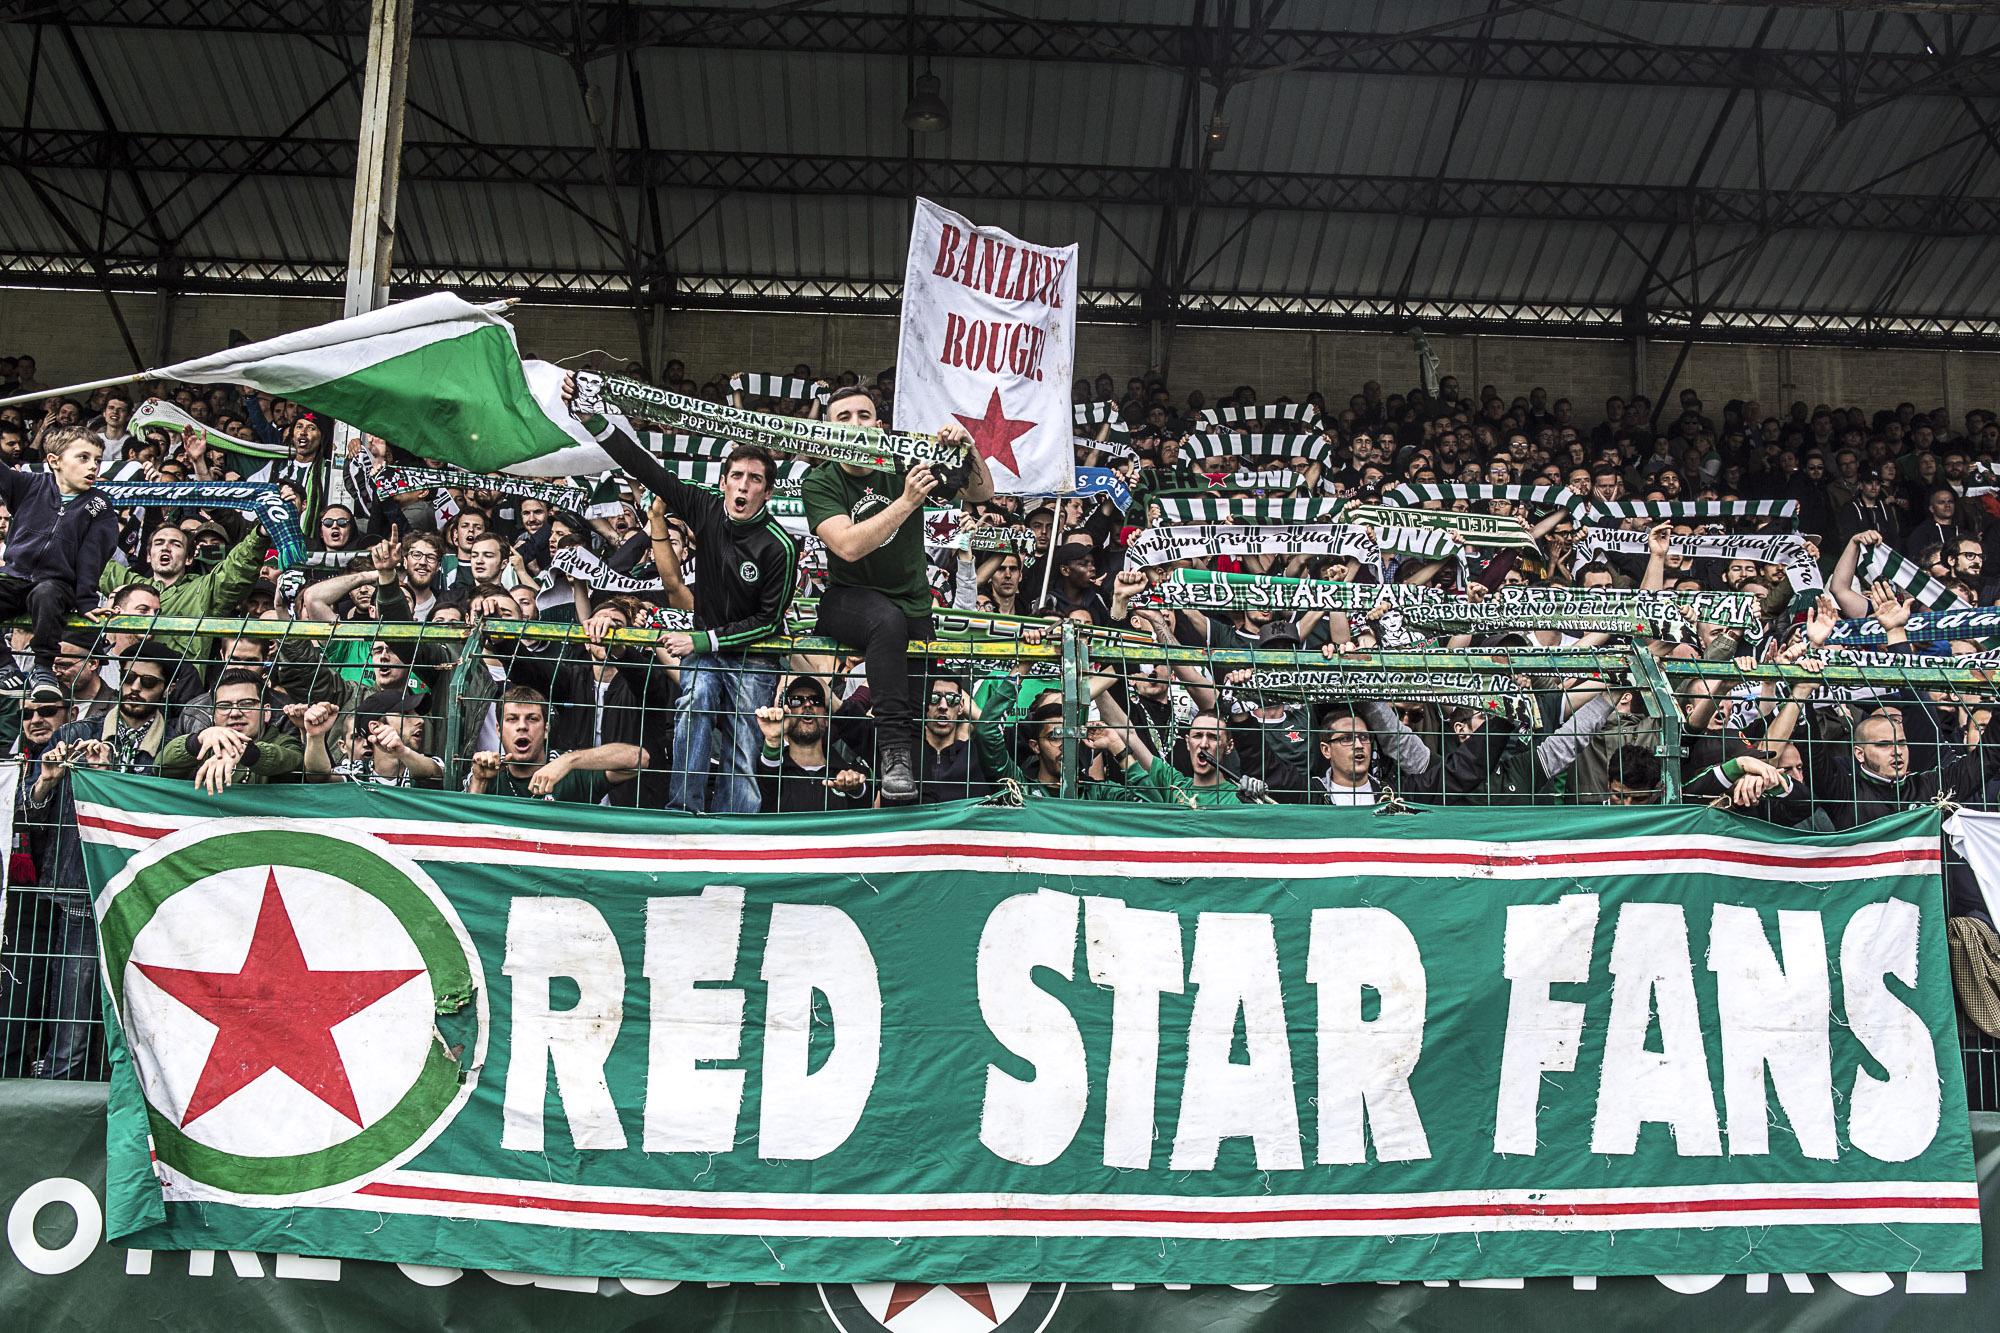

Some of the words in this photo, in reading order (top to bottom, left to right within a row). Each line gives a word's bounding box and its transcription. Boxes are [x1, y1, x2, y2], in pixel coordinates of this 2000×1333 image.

[607, 378, 716, 417] TRIBUNE
[878, 434, 964, 468] NEGRA
[680, 413, 754, 440] POPULAIRE
[757, 432, 776, 445] ET
[779, 436, 871, 464] ANTIRACISTE
[1587, 527, 1648, 545] ribune
[1161, 583, 1236, 606] RED
[1247, 583, 1344, 608] STAR
[1404, 601, 1499, 624] TRIBUNE
[1502, 601, 1557, 618] RINO
[1562, 601, 1629, 617] DELLA
[1635, 601, 1682, 621] NEG
[1537, 621, 1553, 631] ET
[1556, 619, 1633, 633] ANTIRACISTE
[1858, 617, 1930, 636] as
[1411, 672, 1485, 691] DELLA
[501, 885, 883, 1161] RED
[976, 887, 1433, 1171] STAR
[1493, 893, 1943, 1164] FANS
